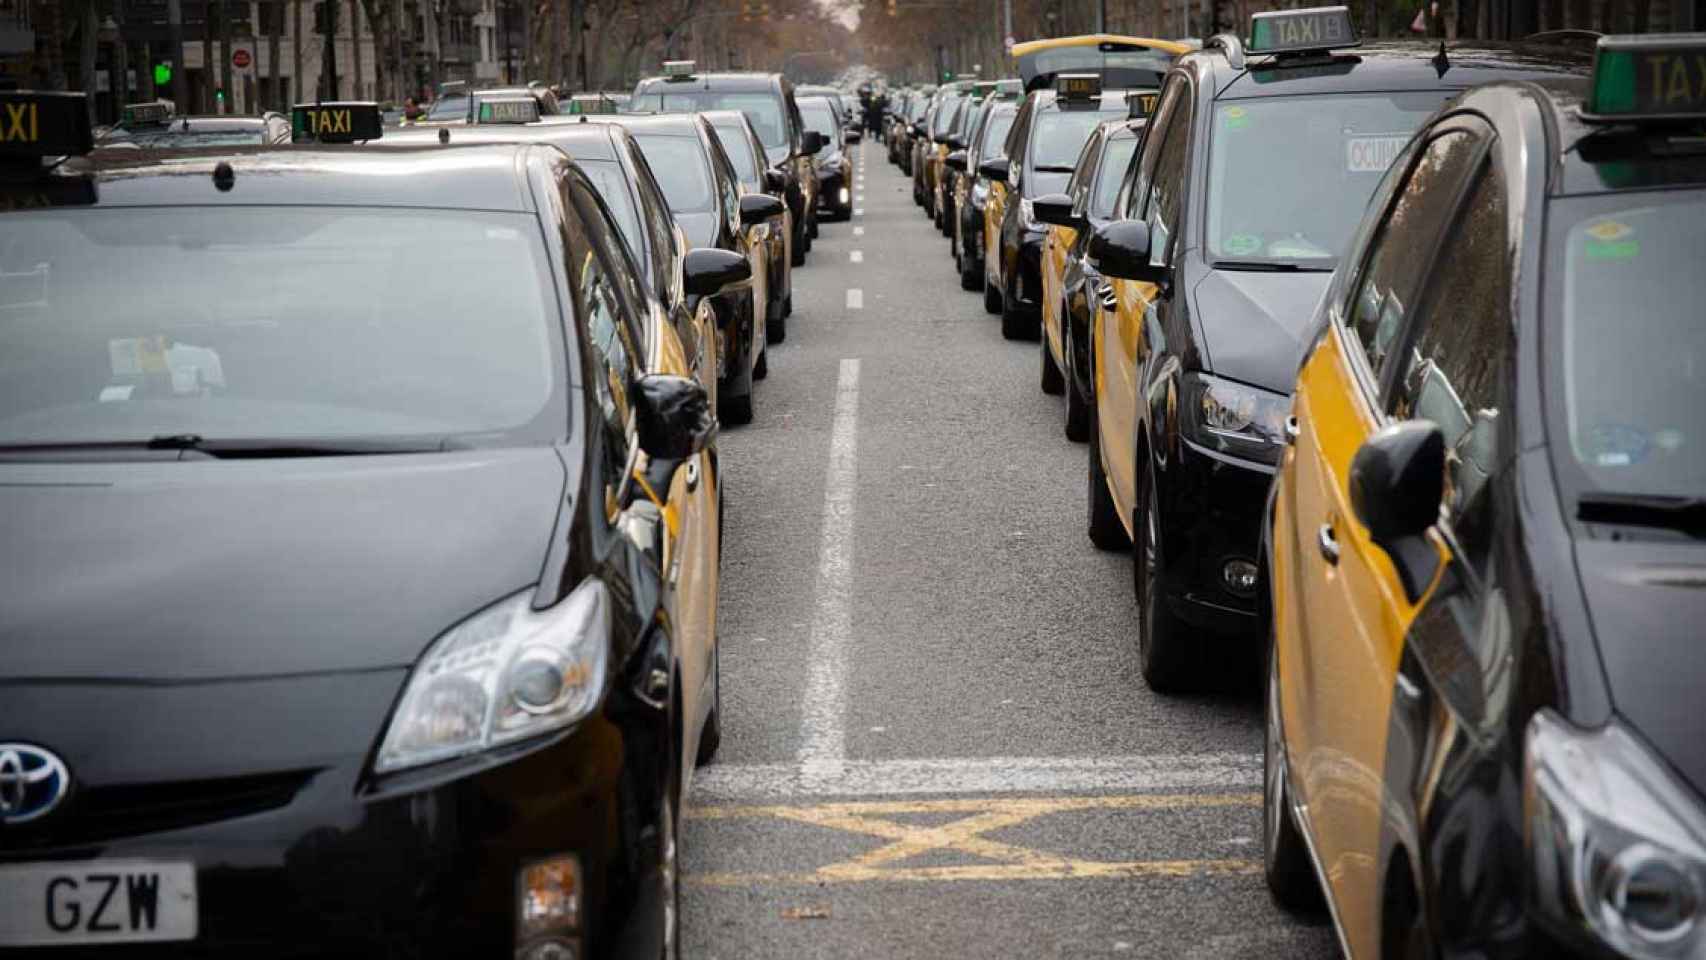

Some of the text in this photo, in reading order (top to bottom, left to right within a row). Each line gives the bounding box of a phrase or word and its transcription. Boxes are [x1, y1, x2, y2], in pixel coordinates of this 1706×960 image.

[1276, 16, 1321, 44] TAXI
[307, 109, 351, 133] TAXI
[45, 873, 160, 933] GZW
